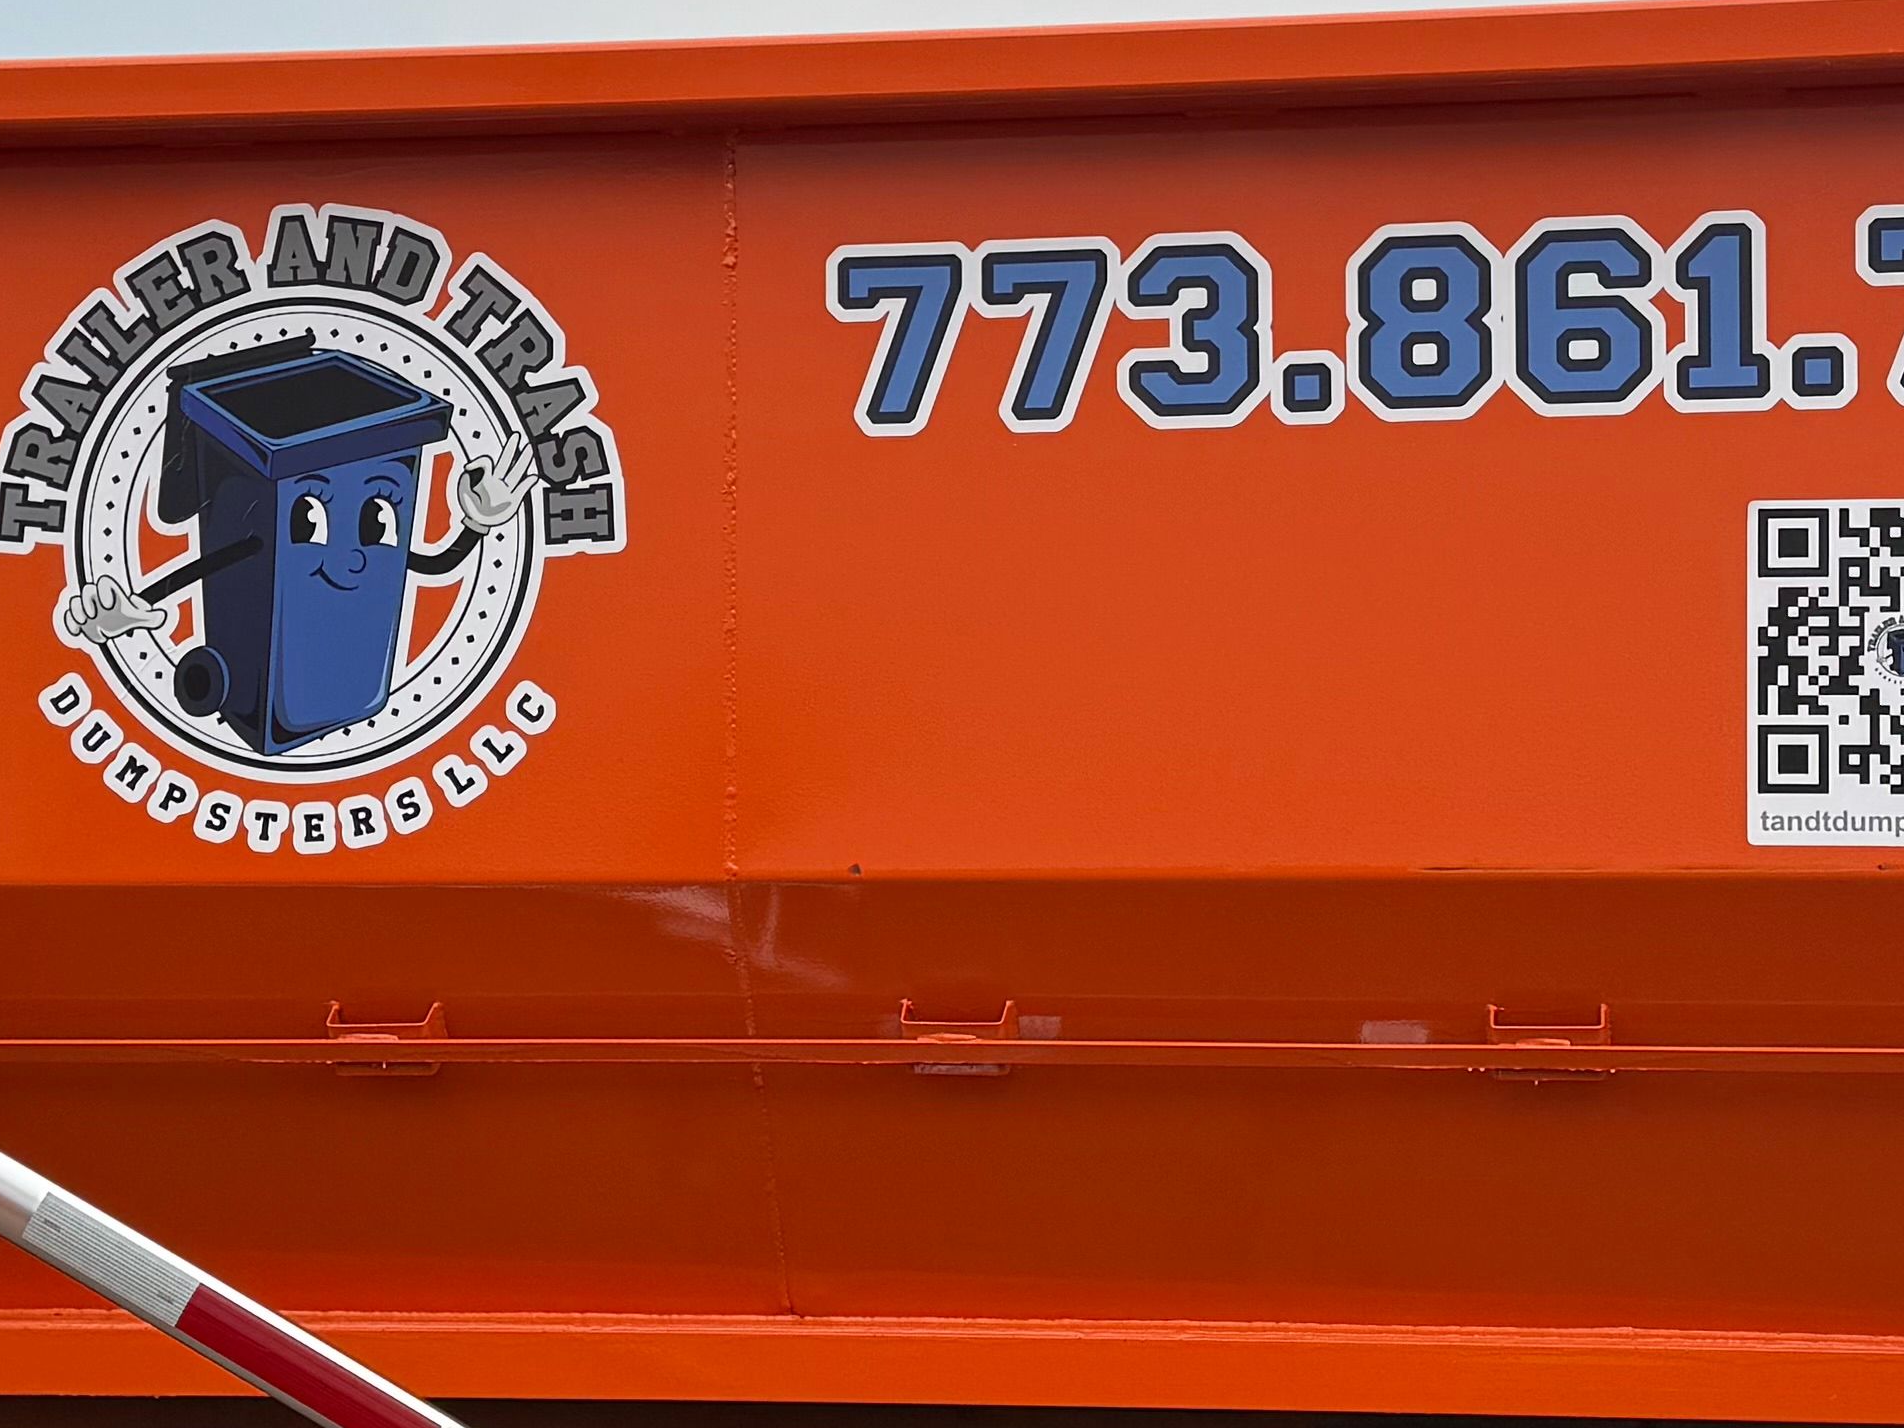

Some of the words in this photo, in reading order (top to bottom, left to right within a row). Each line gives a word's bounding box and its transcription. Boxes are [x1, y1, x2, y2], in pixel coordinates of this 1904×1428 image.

[266, 215, 441, 308] AND
[442, 264, 616, 545] TRASH
[49, 684, 424, 844] DUMPSTERS
[443, 690, 547, 796] LLC
